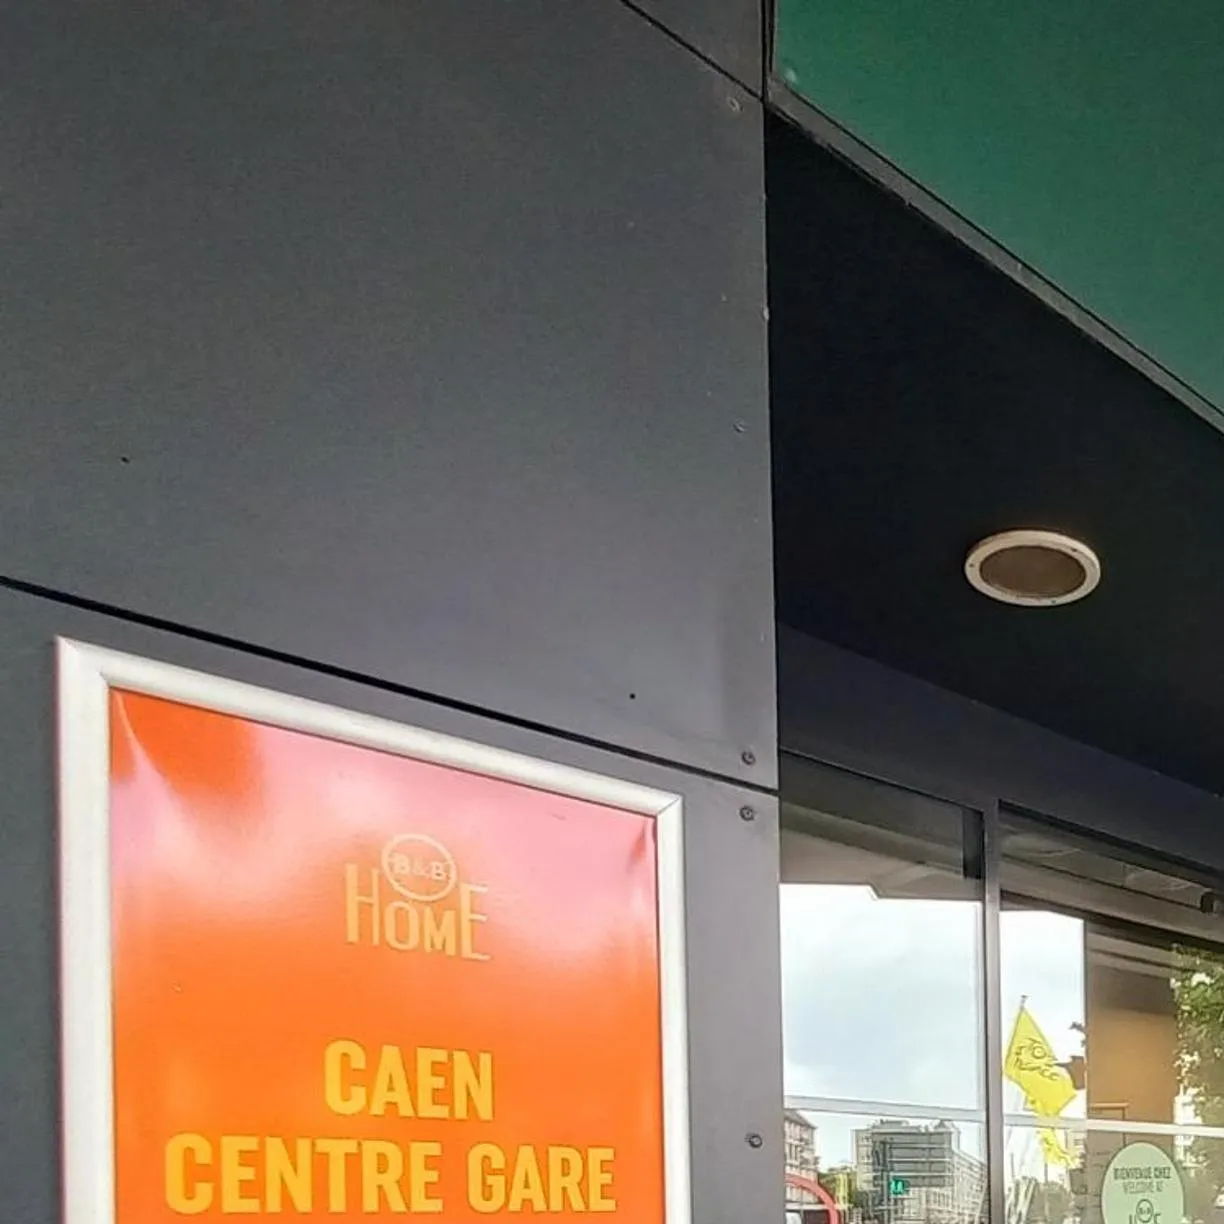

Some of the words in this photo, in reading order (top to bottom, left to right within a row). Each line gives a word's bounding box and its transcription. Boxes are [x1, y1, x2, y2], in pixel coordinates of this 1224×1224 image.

[392, 852, 447, 881] B&B
[344, 862, 490, 961] HOME
[323, 1039, 494, 1121] CAEN
[164, 1132, 444, 1215] CENTRE
[466, 1142, 617, 1214] GARE
